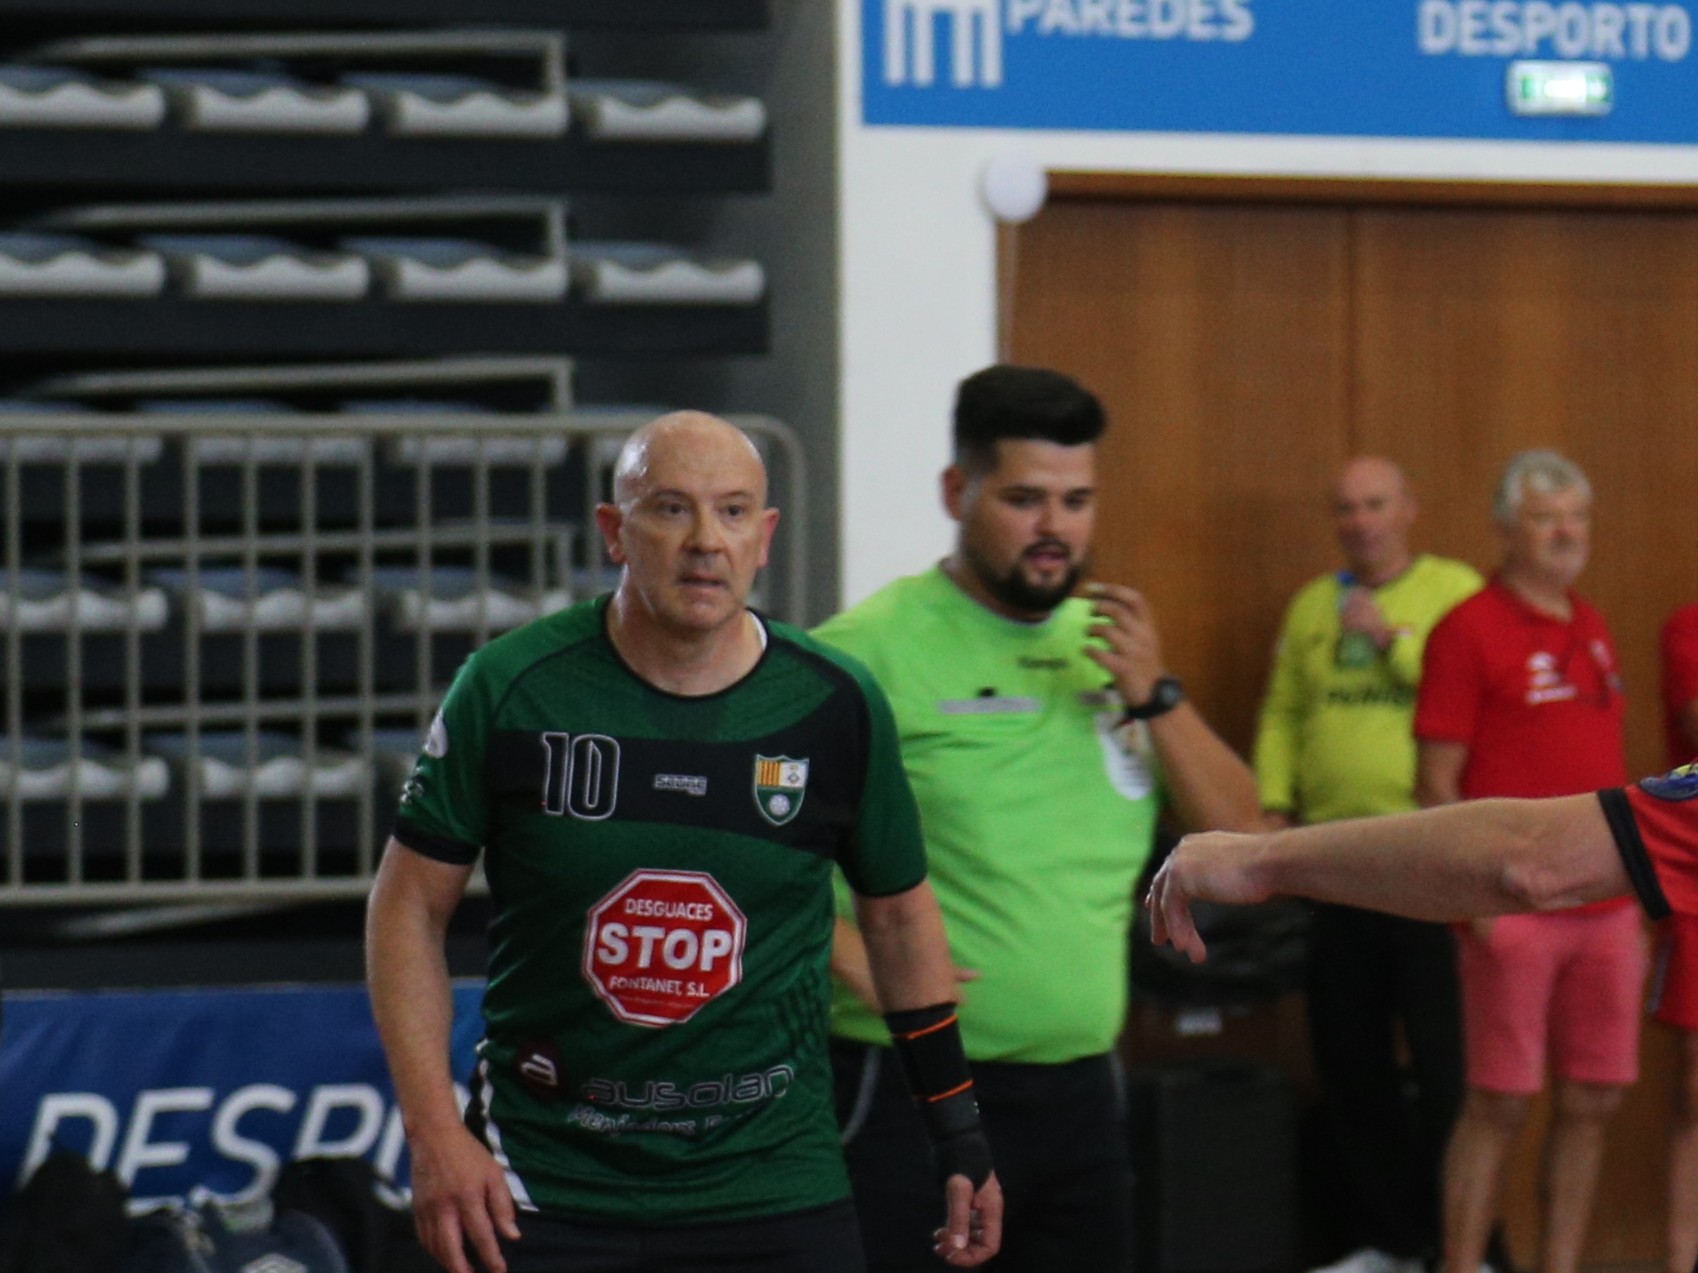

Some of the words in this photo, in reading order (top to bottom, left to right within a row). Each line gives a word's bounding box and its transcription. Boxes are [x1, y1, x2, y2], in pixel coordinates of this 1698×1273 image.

[1007, 0, 1255, 41] PAREDES
[1418, 2, 1692, 60] DESPORTO
[541, 731, 620, 820] 10
[625, 899, 713, 921] DESGUACES
[598, 922, 733, 971] STOP
[581, 1064, 794, 1112] ausolan
